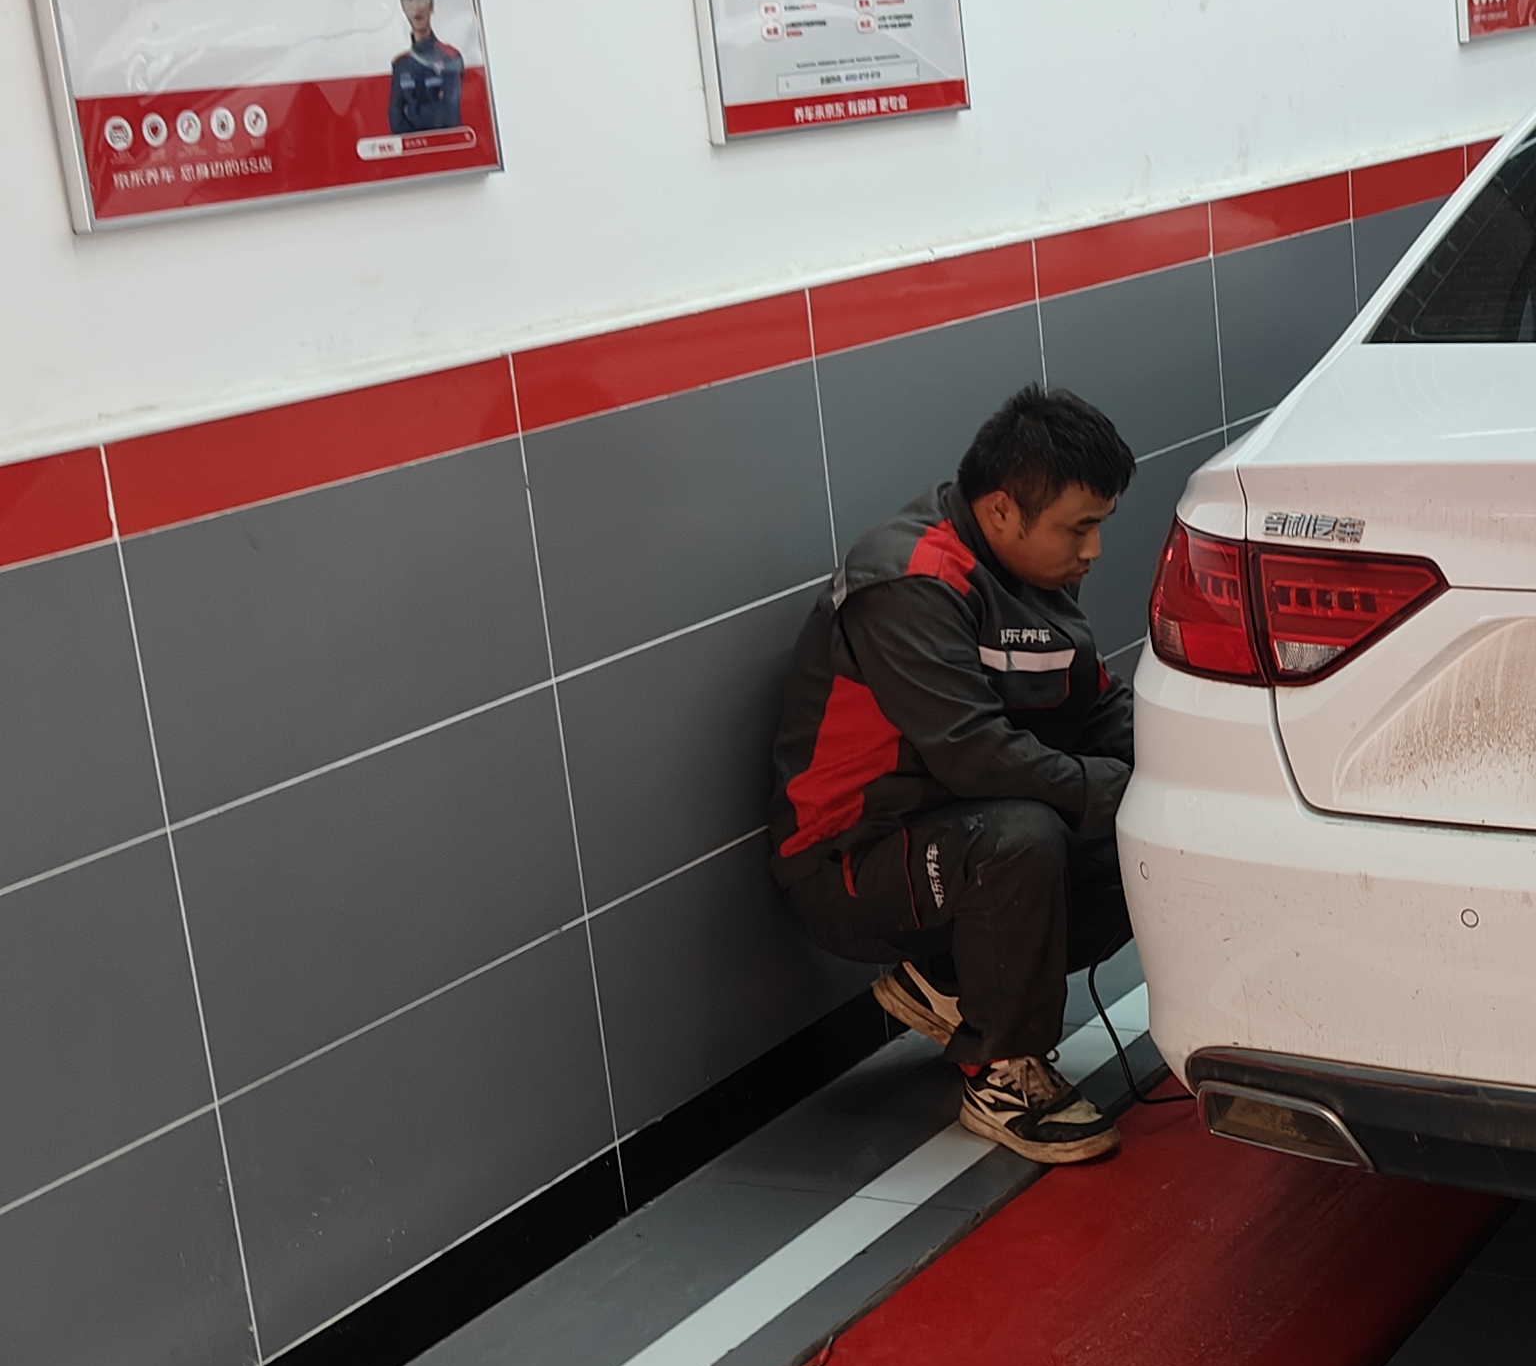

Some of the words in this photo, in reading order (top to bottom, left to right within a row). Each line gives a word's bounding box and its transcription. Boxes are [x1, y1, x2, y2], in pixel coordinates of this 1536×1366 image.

[112, 165, 175, 191] 京东养车
[1262, 511, 1365, 543] 吉利汽车
